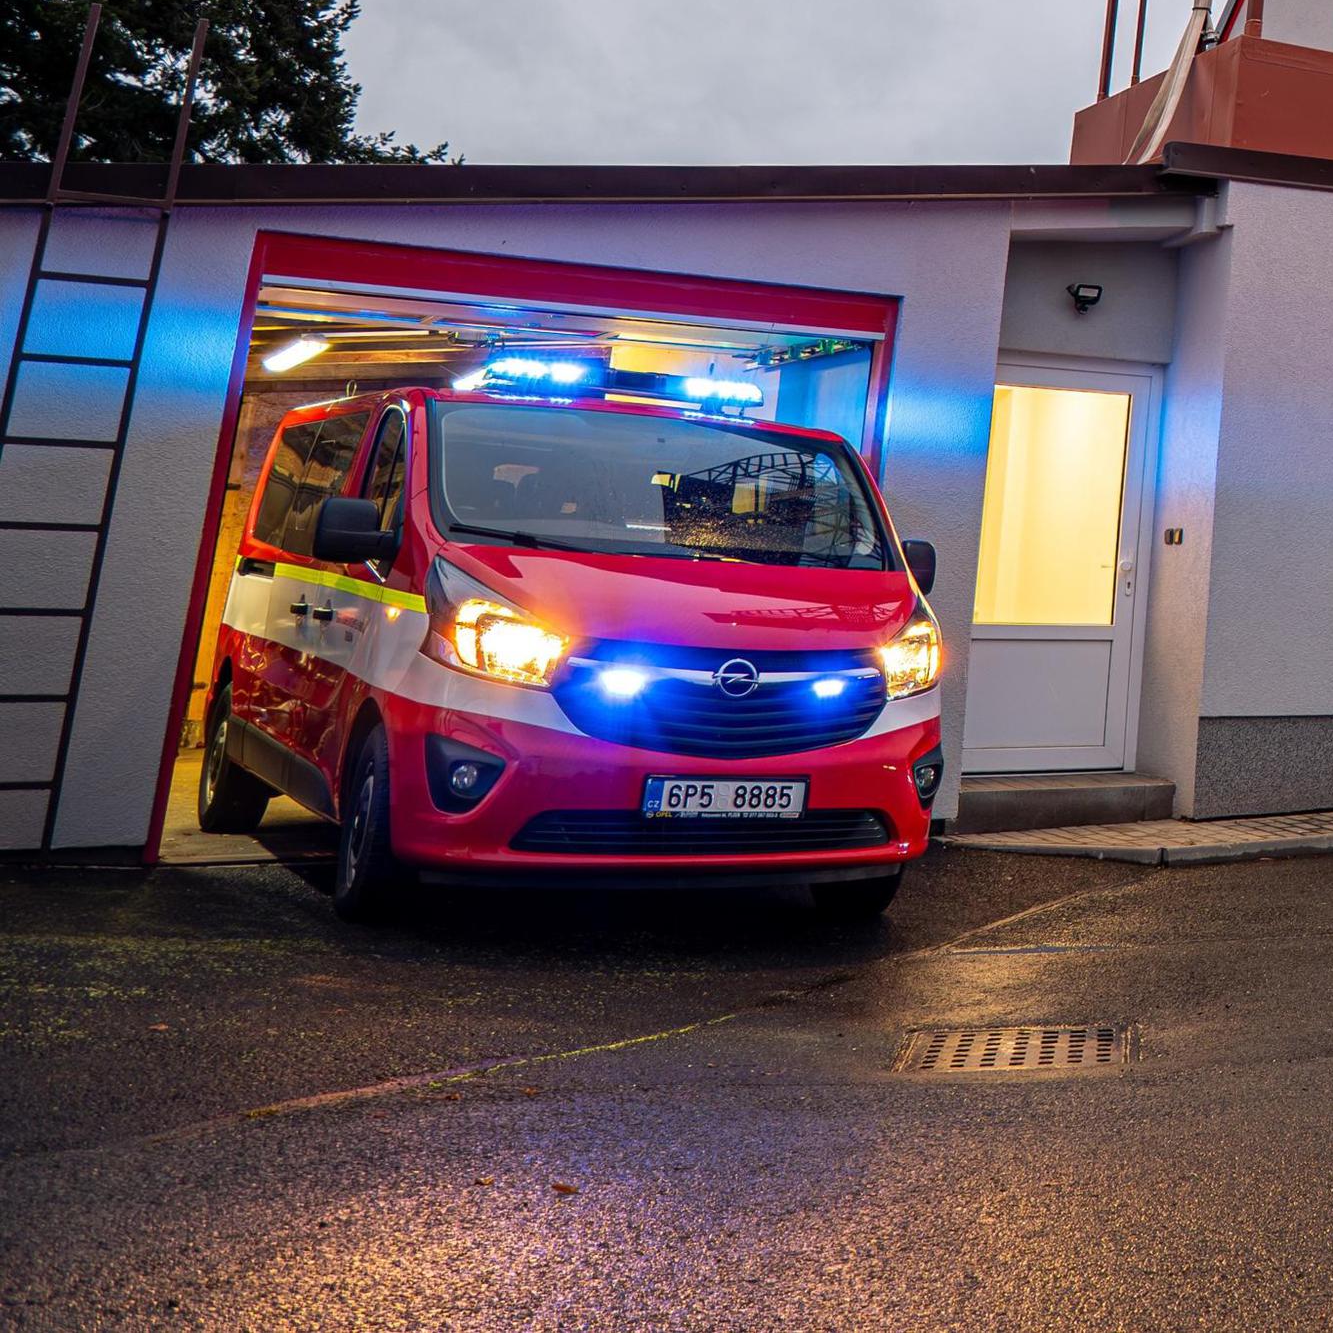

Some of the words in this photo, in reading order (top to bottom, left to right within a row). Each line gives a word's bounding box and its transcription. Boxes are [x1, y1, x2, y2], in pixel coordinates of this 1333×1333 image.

[647, 800, 660, 809] CZ
[668, 783, 715, 809] 6P5
[733, 784, 794, 809] 8885
